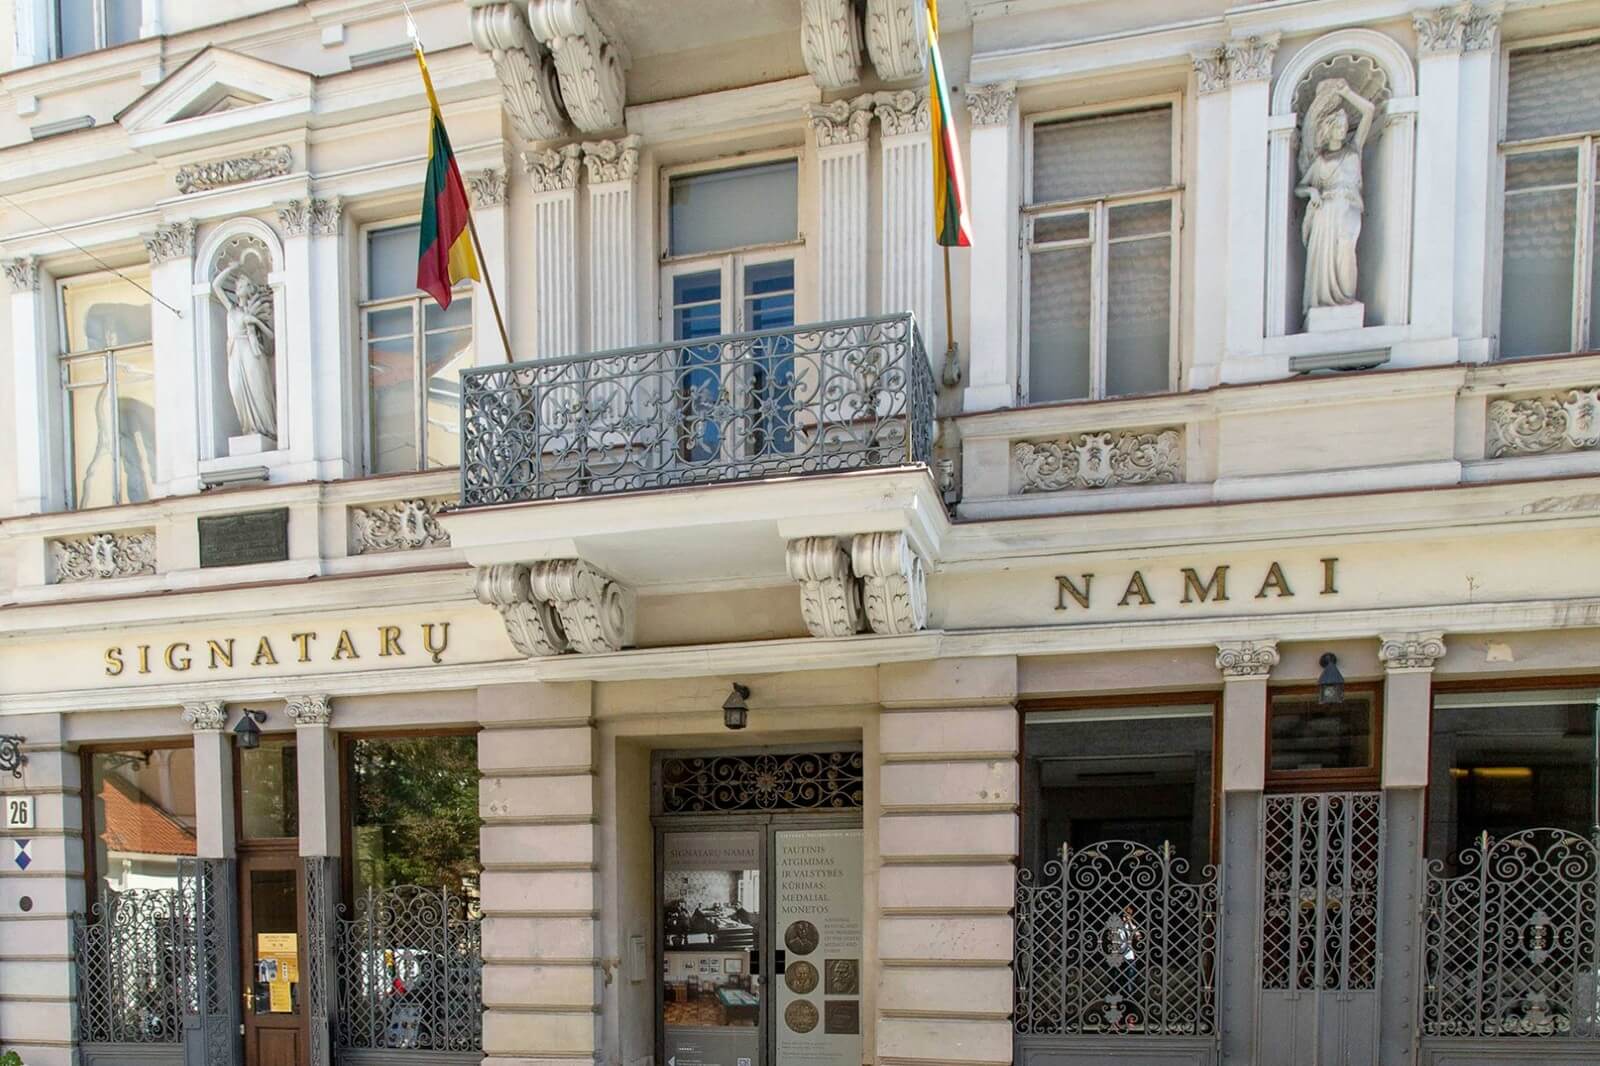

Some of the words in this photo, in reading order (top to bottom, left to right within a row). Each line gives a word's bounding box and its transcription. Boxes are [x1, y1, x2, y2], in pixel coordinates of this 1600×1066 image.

[1054, 557, 1339, 610] NAMAI
[105, 622, 450, 676] SIGNATARŲ
[10, 800, 28, 825] 26
[723, 848, 754, 857] NAMAI
[783, 846, 826, 854] TAUTINIS
[782, 857, 835, 866] ATGIMIMAS
[782, 870, 791, 878] IR
[782, 905, 830, 914] MONETOS
